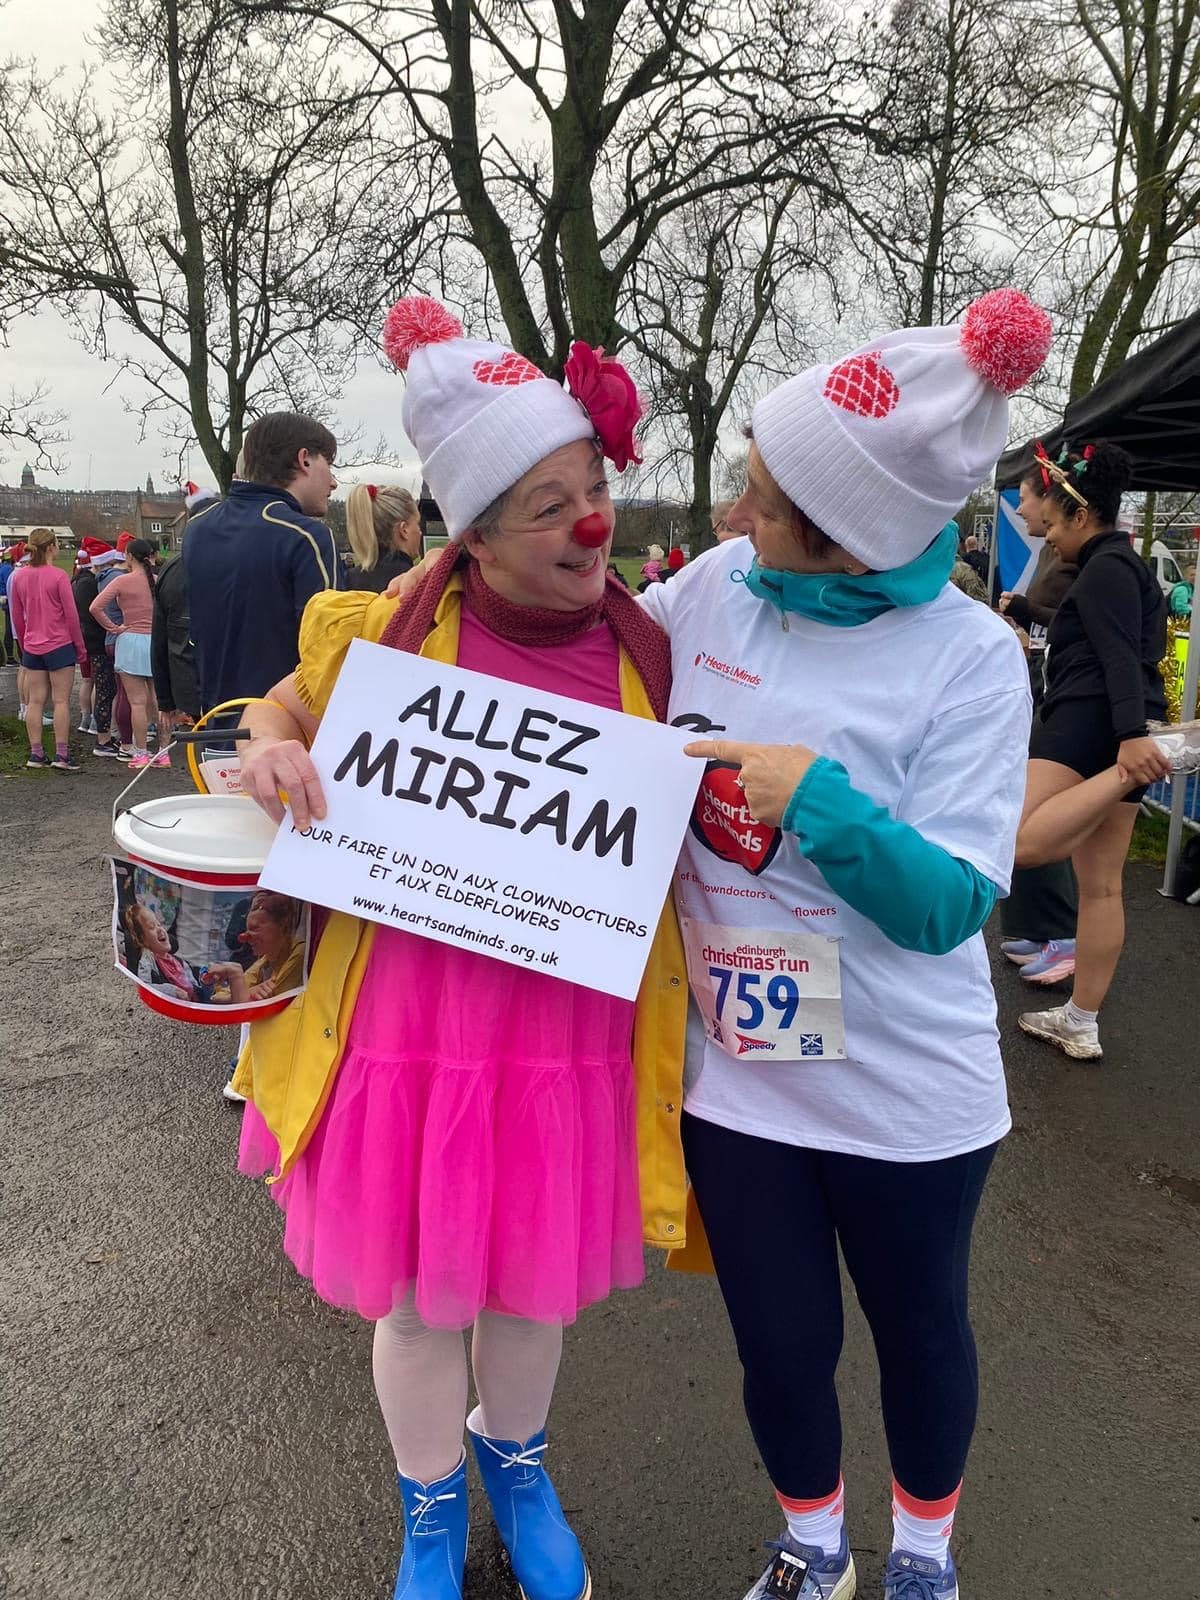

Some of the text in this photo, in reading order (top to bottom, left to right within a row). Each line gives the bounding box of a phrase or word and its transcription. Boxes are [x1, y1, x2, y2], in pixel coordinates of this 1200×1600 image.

[398, 685, 600, 775] ALLEZ
[333, 731, 637, 867] MIRIAM
[337, 835, 388, 860] FAIRE
[392, 851, 417, 868] UN
[421, 860, 459, 881] DON
[463, 873, 498, 893] AUX
[502, 885, 648, 938] CLOWNDOCTUERS
[369, 864, 560, 932] ET AUX ELDERFLOWERS
[680, 871, 690, 881] of
[702, 882, 767, 899] lowndoctors
[352, 896, 559, 966] www.heartsandminds.org.uk
[702, 946, 809, 972] christmas run
[736, 945, 786, 959] edinburgh
[709, 966, 800, 1030] 759
[743, 1040, 776, 1051] Speedy
